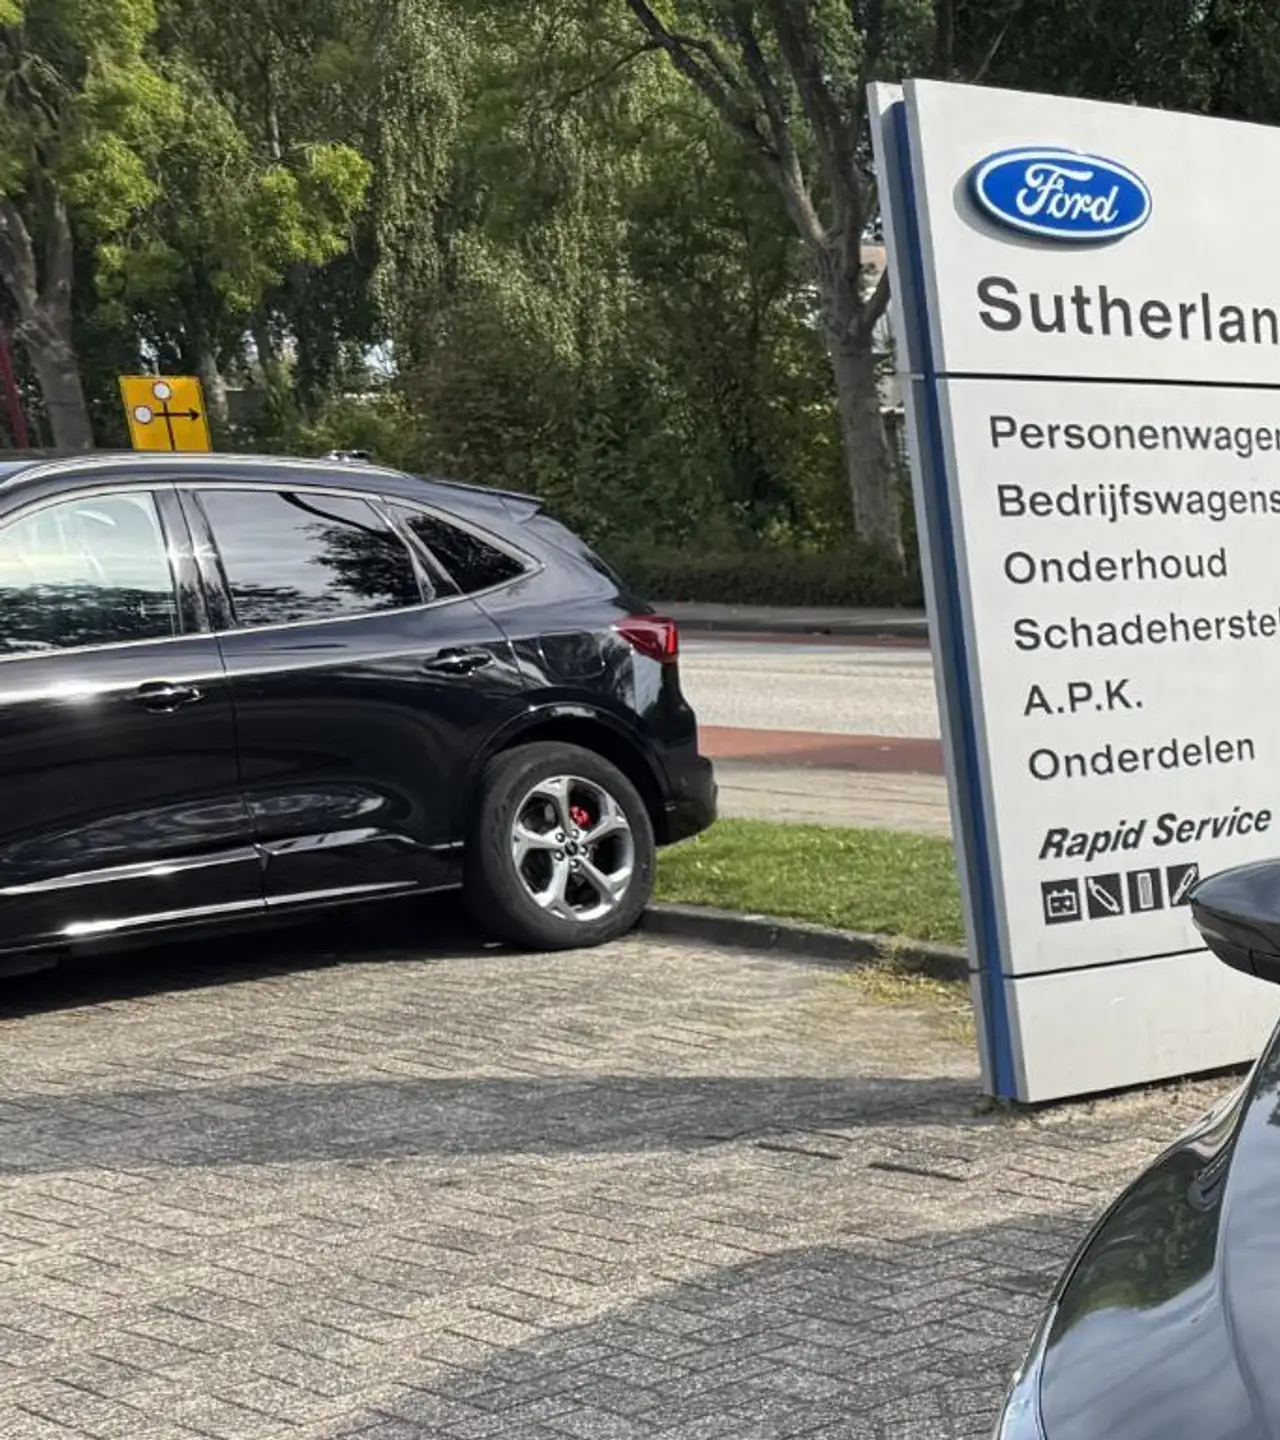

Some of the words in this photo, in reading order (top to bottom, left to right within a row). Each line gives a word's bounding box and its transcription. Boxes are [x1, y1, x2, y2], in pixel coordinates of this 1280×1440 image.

[1015, 162, 1120, 225] Ford
[1004, 547, 1228, 585] Onderhoud
[1024, 678, 1143, 716] A.P.K.
[1028, 735, 1255, 781] Onderdelen
[1038, 819, 1147, 862] Rapid
[1152, 806, 1272, 847] Service
